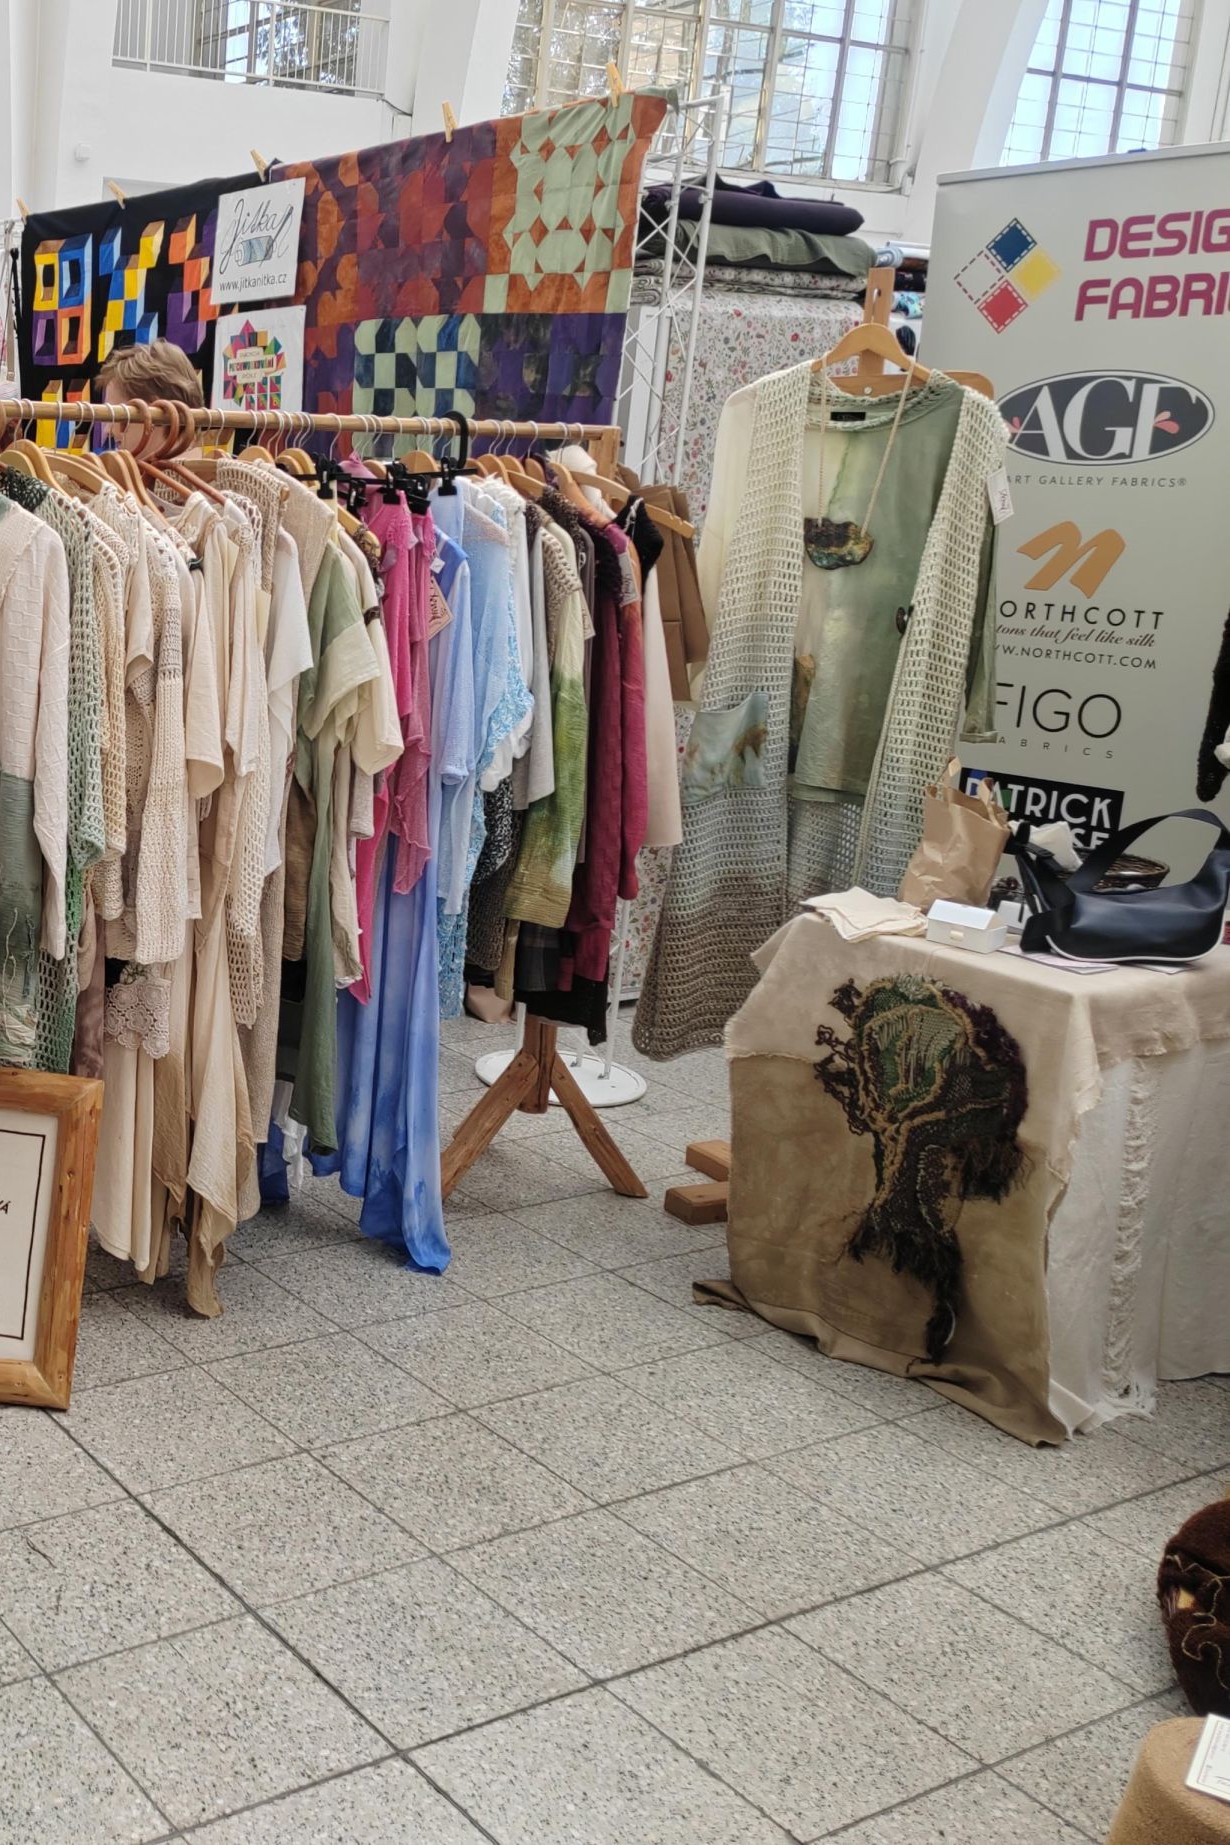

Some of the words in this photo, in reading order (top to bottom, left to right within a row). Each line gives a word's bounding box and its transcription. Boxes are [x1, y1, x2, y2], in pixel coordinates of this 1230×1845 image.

[219, 274, 287, 292] www.jitkanitka.cz
[1075, 271, 1230, 320] FABRI
[1038, 475, 1104, 486] GALLERY
[999, 600, 1165, 630] ORTHCOTT
[995, 624, 1027, 637] tons
[1030, 624, 1061, 640] that
[1054, 627, 1096, 645] feel
[1095, 630, 1124, 646] like
[1125, 633, 1156, 648] silk
[998, 736, 1114, 760] ABRICS
